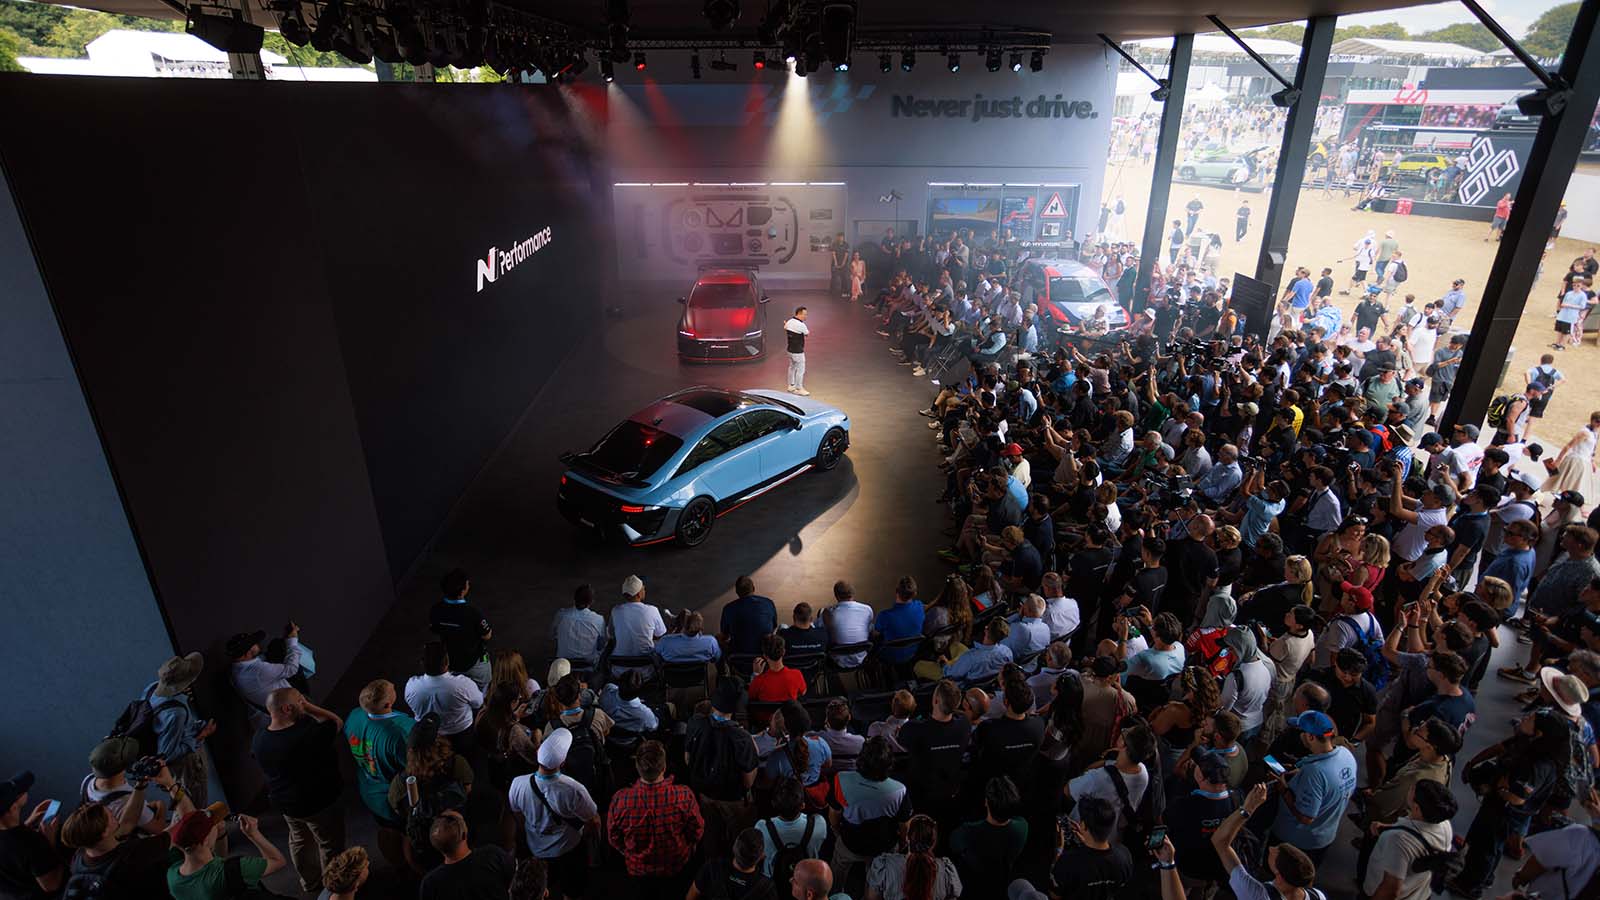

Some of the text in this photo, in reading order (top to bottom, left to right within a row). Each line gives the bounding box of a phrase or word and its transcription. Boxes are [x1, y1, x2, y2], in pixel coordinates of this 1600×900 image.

[891, 94, 1098, 123] Never just drive.
[499, 225, 552, 275] Performance
